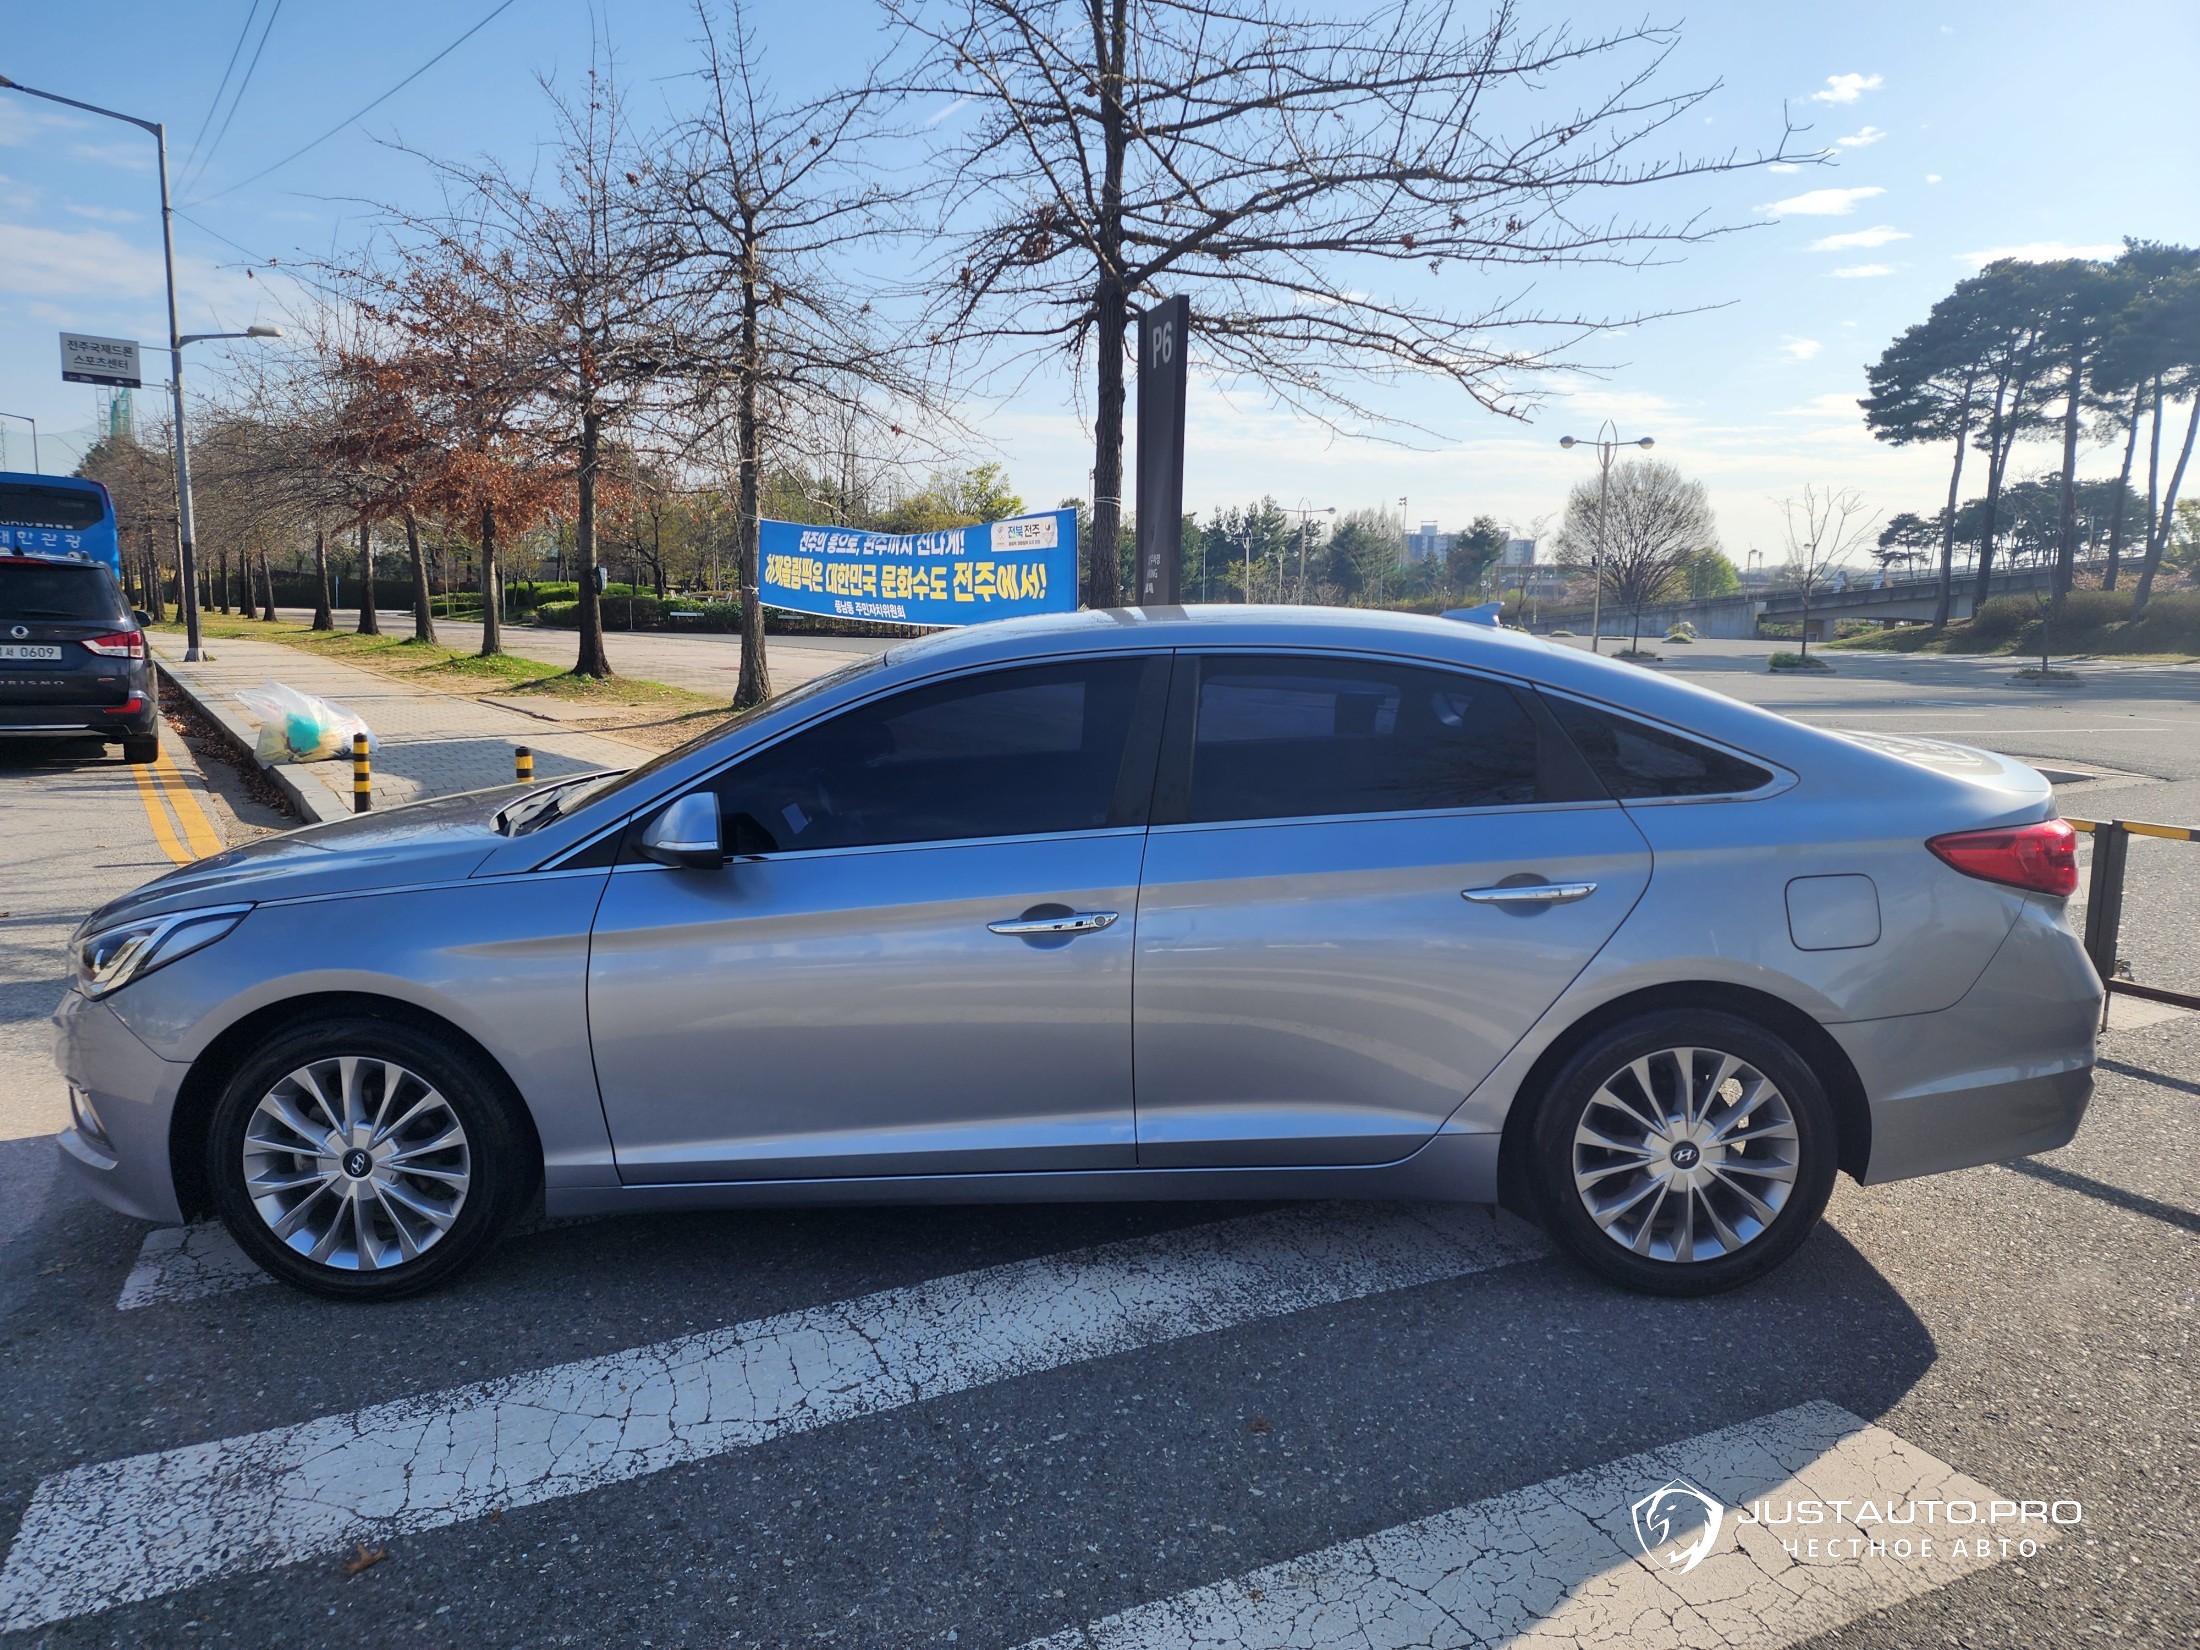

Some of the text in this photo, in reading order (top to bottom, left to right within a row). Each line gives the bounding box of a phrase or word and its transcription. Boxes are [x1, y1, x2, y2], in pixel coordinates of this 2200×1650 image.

[67, 340, 134, 358] 전주국제드론
[1152, 320, 1173, 369] P6
[73, 354, 129, 371] 스포츠센터
[799, 530, 828, 554] 전주의
[917, 529, 966, 557] 신나게!
[764, 553, 1048, 602] 하계올림픽은 대한민국 문화수도 전주에서!
[834, 599, 907, 620] 풍남동 주민자치위원회
[20, 646, 55, 659] 0609
